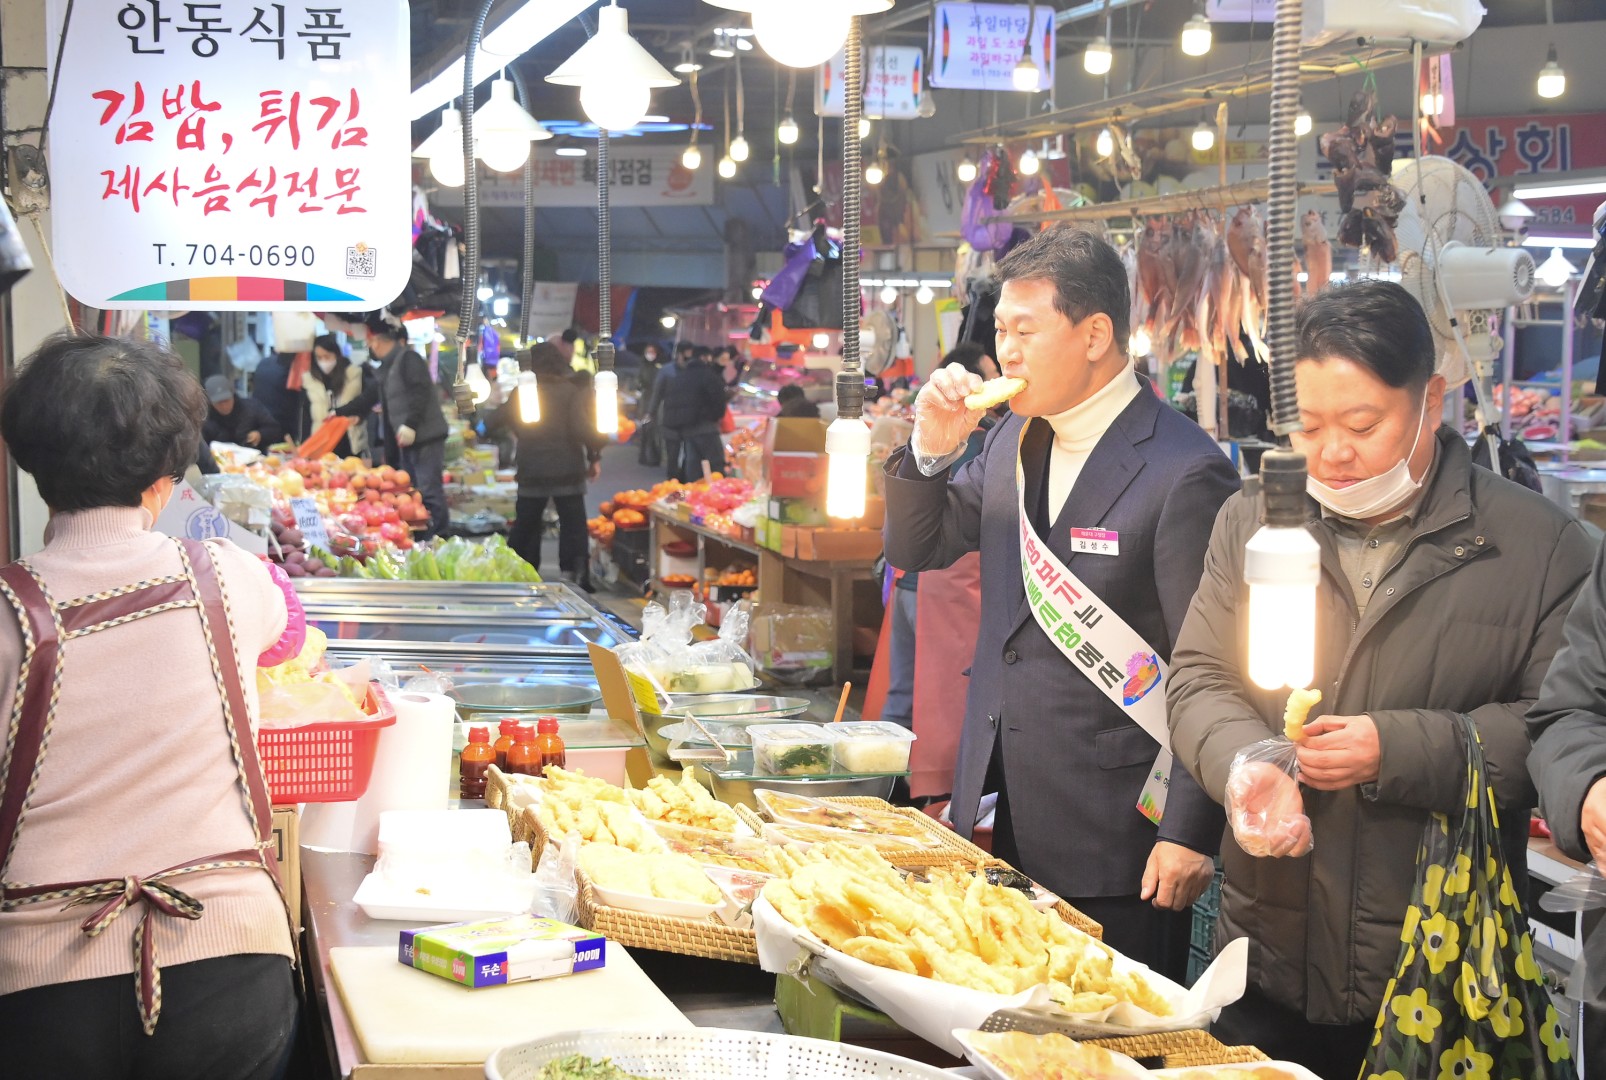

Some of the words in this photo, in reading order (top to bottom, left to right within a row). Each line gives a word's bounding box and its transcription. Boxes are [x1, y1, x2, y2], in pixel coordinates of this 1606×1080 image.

[116, 0, 353, 61] 안동식품
[969, 15, 1028, 33] 과일마당
[91, 80, 234, 155] 김밥,
[251, 87, 369, 150] 튀김
[99, 163, 368, 218] 제사음식전문
[152, 243, 176, 267] T.
[185, 244, 316, 267] 704-0690
[481, 962, 501, 978] 두손
